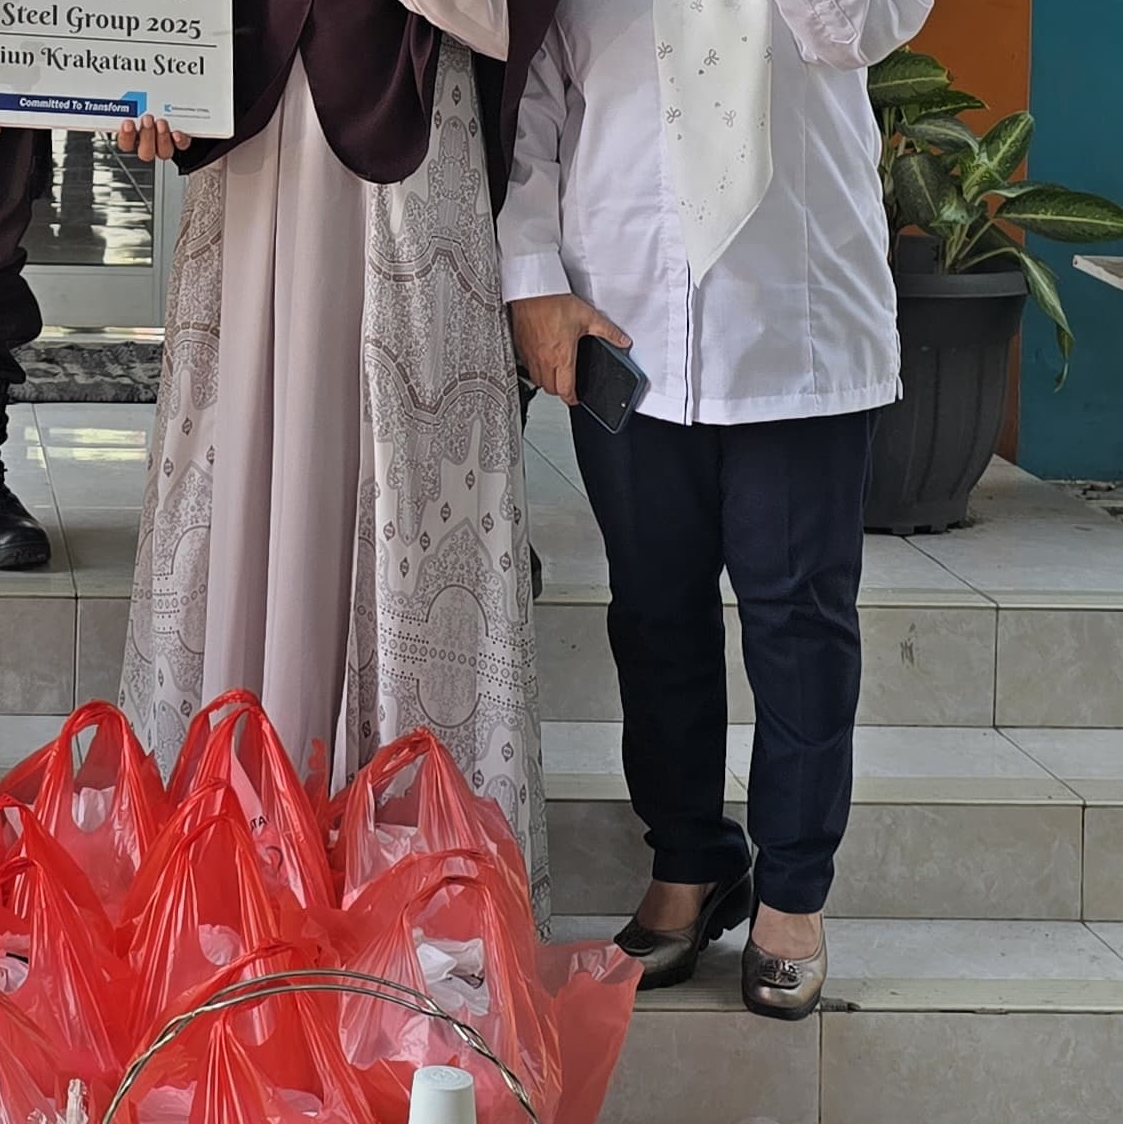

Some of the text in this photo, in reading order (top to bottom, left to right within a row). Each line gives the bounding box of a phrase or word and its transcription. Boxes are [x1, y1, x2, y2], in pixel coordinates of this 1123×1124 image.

[1, 2, 58, 26] Steel
[66, 6, 140, 36] Group
[146, 17, 201, 40] 2025
[41, 47, 146, 73] Krakatau
[153, 54, 205, 75] Steel
[19, 97, 130, 113] Committed To Transform
